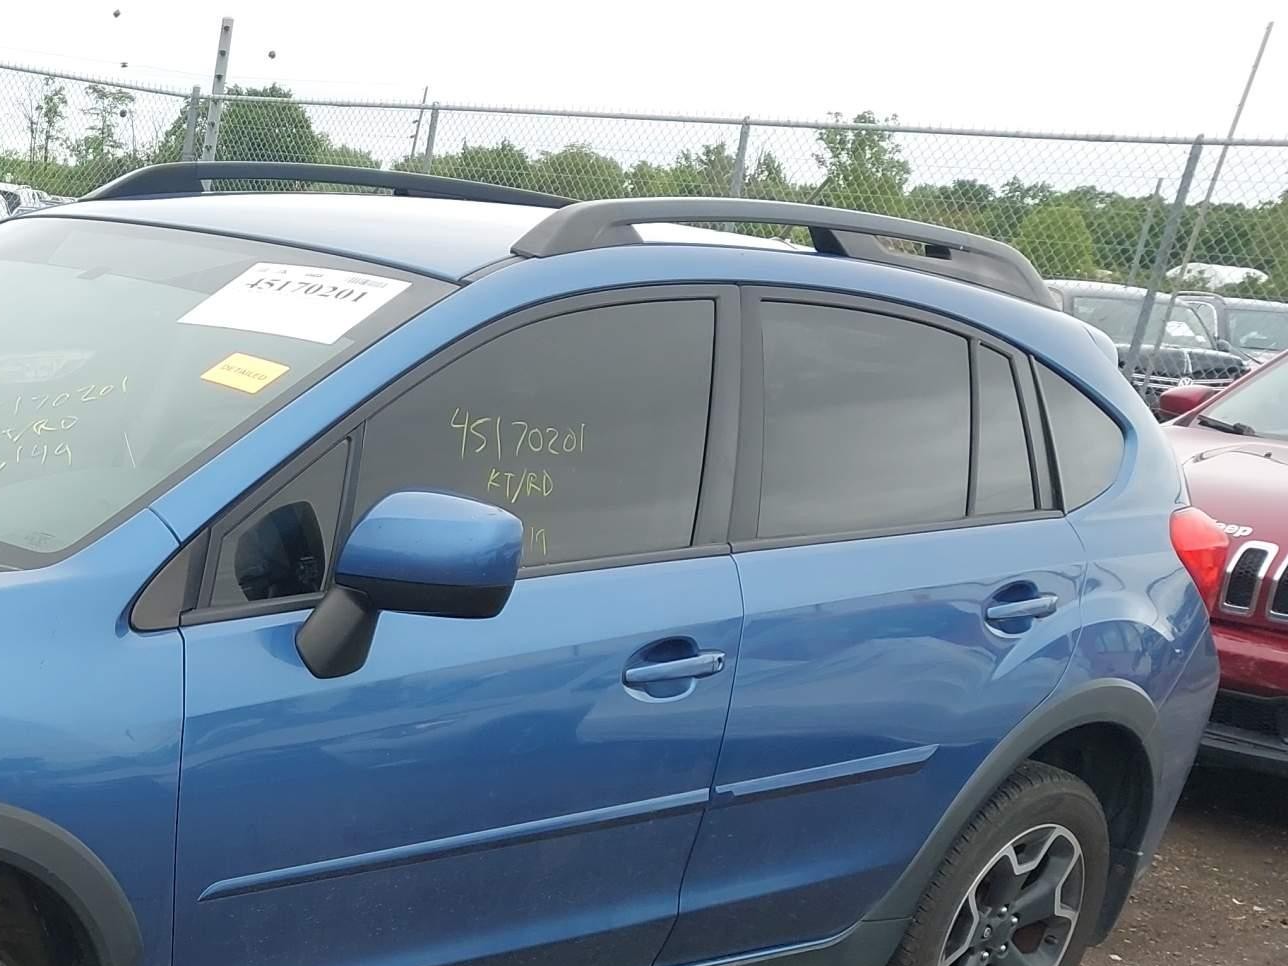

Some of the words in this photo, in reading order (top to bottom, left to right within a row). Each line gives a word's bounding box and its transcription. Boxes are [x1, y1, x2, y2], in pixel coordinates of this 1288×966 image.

[245, 277, 369, 302] 45170201
[221, 363, 268, 381] DETAILED
[450, 407, 586, 461] 45170201
[487, 468, 554, 503] KT/RD
[1216, 522, 1253, 537] eep
